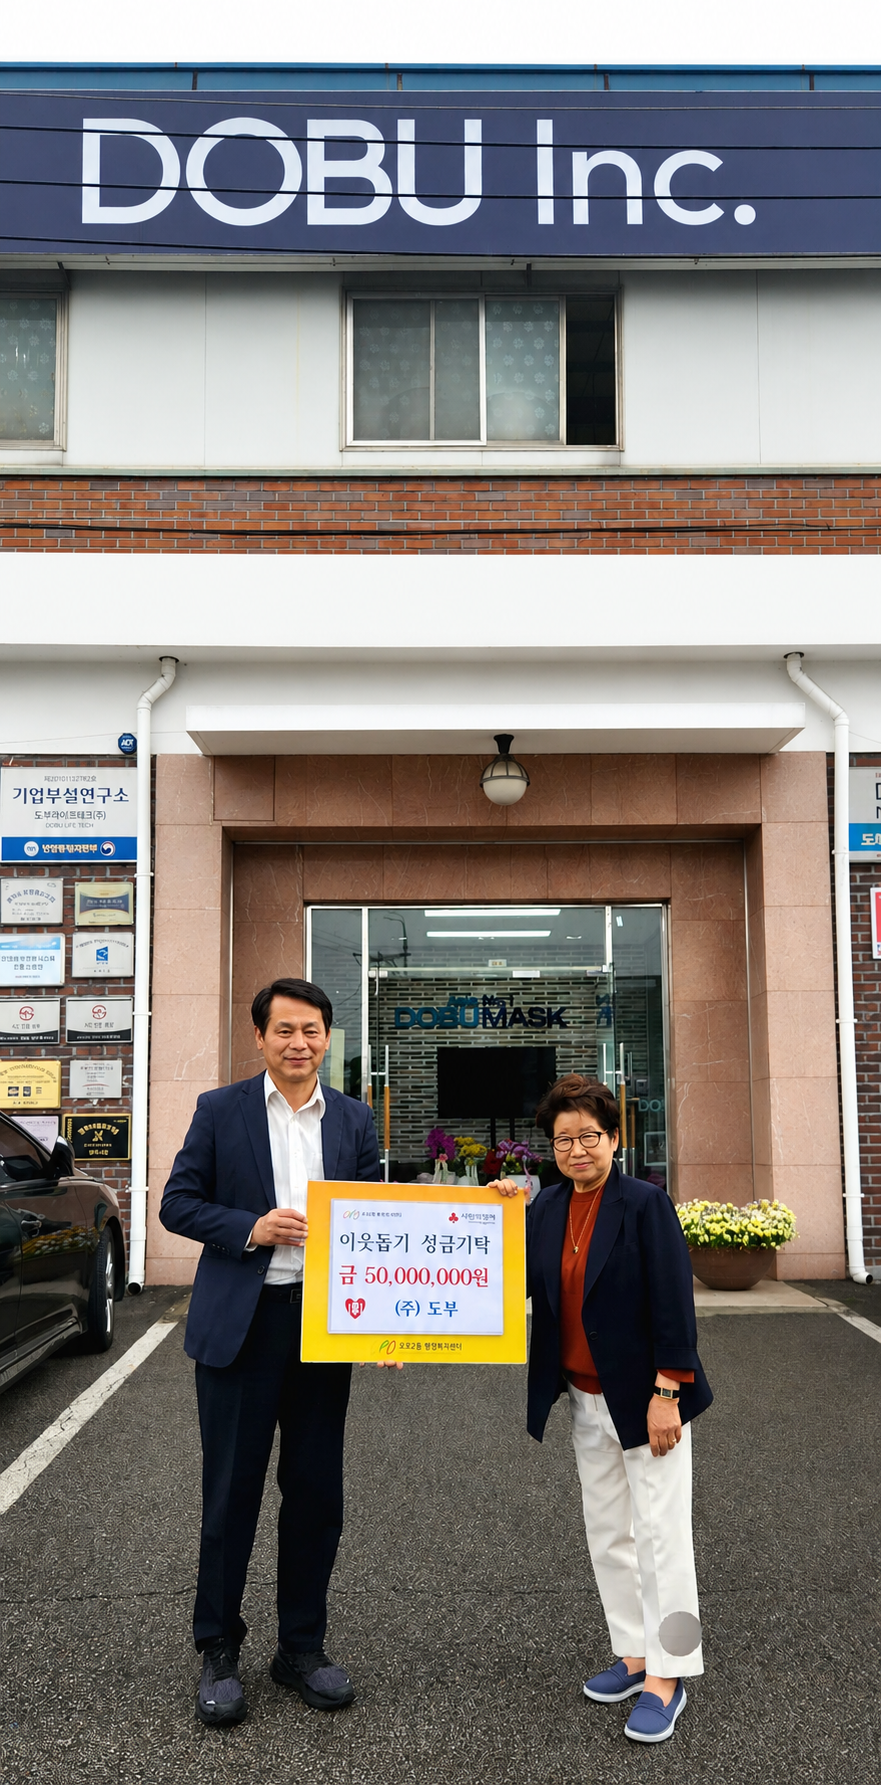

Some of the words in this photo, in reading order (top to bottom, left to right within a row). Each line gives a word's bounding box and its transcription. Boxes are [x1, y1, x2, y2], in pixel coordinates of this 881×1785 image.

[82, 117, 484, 227] DOBU
[536, 118, 757, 227] Inc.
[12, 787, 130, 805] 기업부설연구소
[339, 1231, 410, 1254] 이웃돕기
[421, 1233, 491, 1255] 성금기탁
[339, 1264, 357, 1286] 금
[364, 1266, 489, 1288] 50,000,000원
[395, 1299, 420, 1318] (주)
[427, 1300, 459, 1318] 도부
